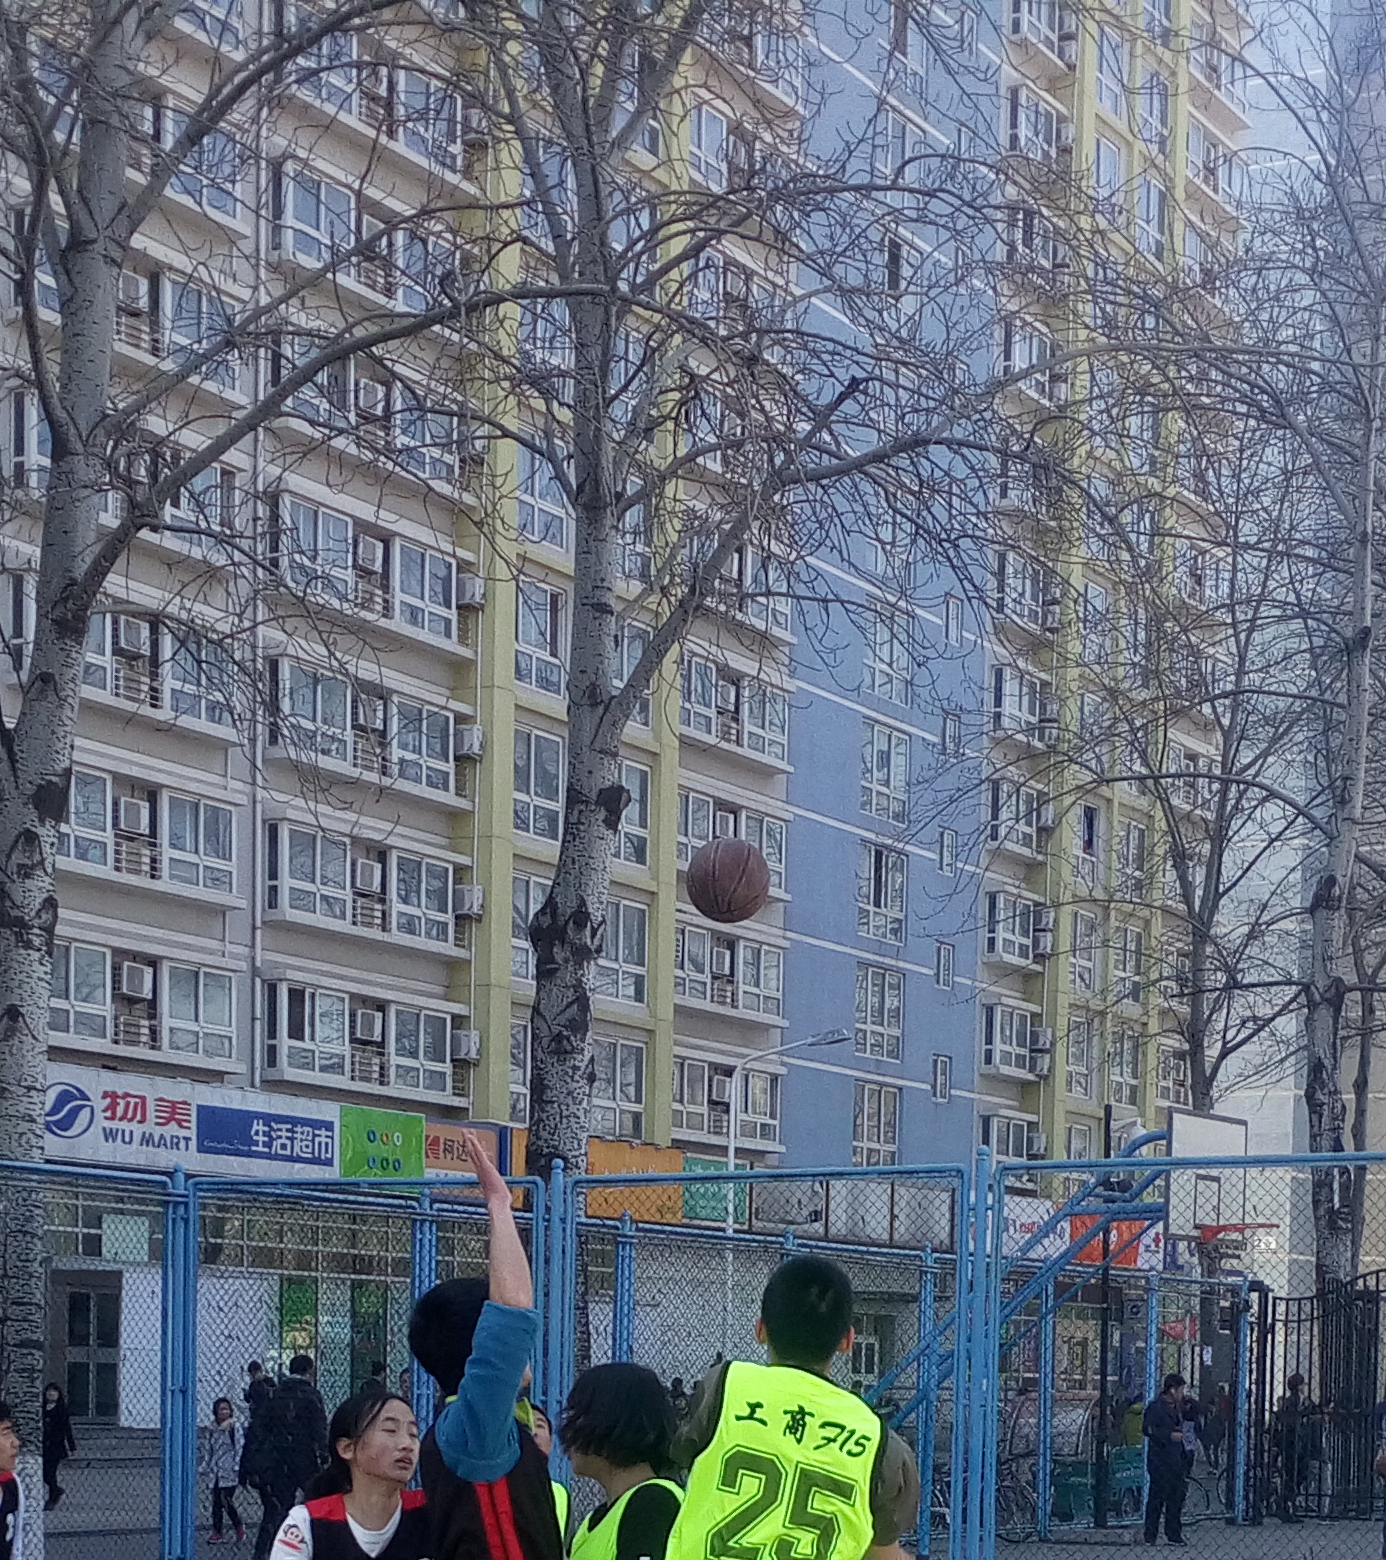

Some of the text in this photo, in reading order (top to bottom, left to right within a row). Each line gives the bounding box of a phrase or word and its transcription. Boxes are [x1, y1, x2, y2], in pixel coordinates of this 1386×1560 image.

[101, 1090, 192, 1131] 物美
[102, 1126, 135, 1146] WU
[139, 1131, 193, 1152] MART
[250, 1119, 333, 1160] 生活超市
